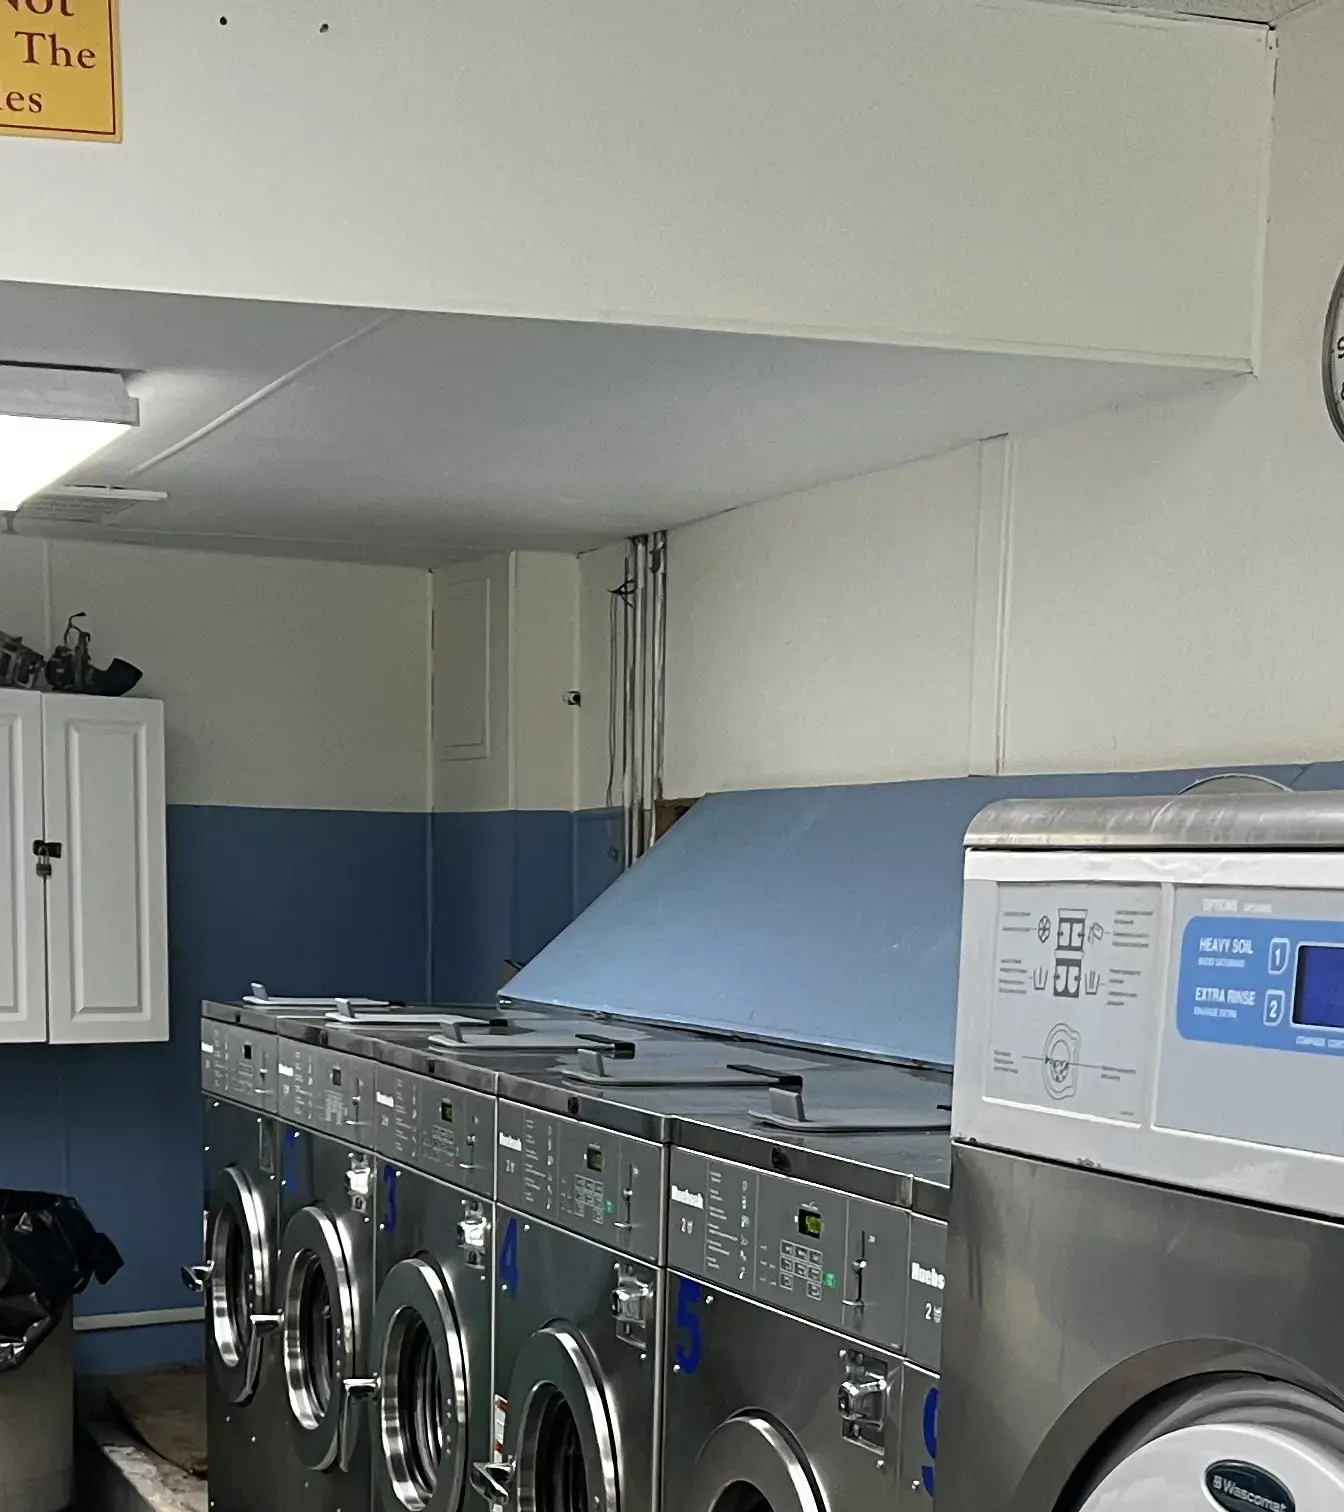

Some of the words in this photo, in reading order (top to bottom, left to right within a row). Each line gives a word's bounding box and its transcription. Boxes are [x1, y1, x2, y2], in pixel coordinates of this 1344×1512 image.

[14, 30, 97, 69] The
[1198, 936, 1232, 953] HEAVY
[1232, 938, 1254, 954] SOIL
[1274, 947, 1281, 967] 1
[1194, 986, 1226, 1003] EXTRA
[1269, 999, 1278, 1019] 2
[498, 1216, 520, 1300] 4
[674, 1276, 703, 1375] 5
